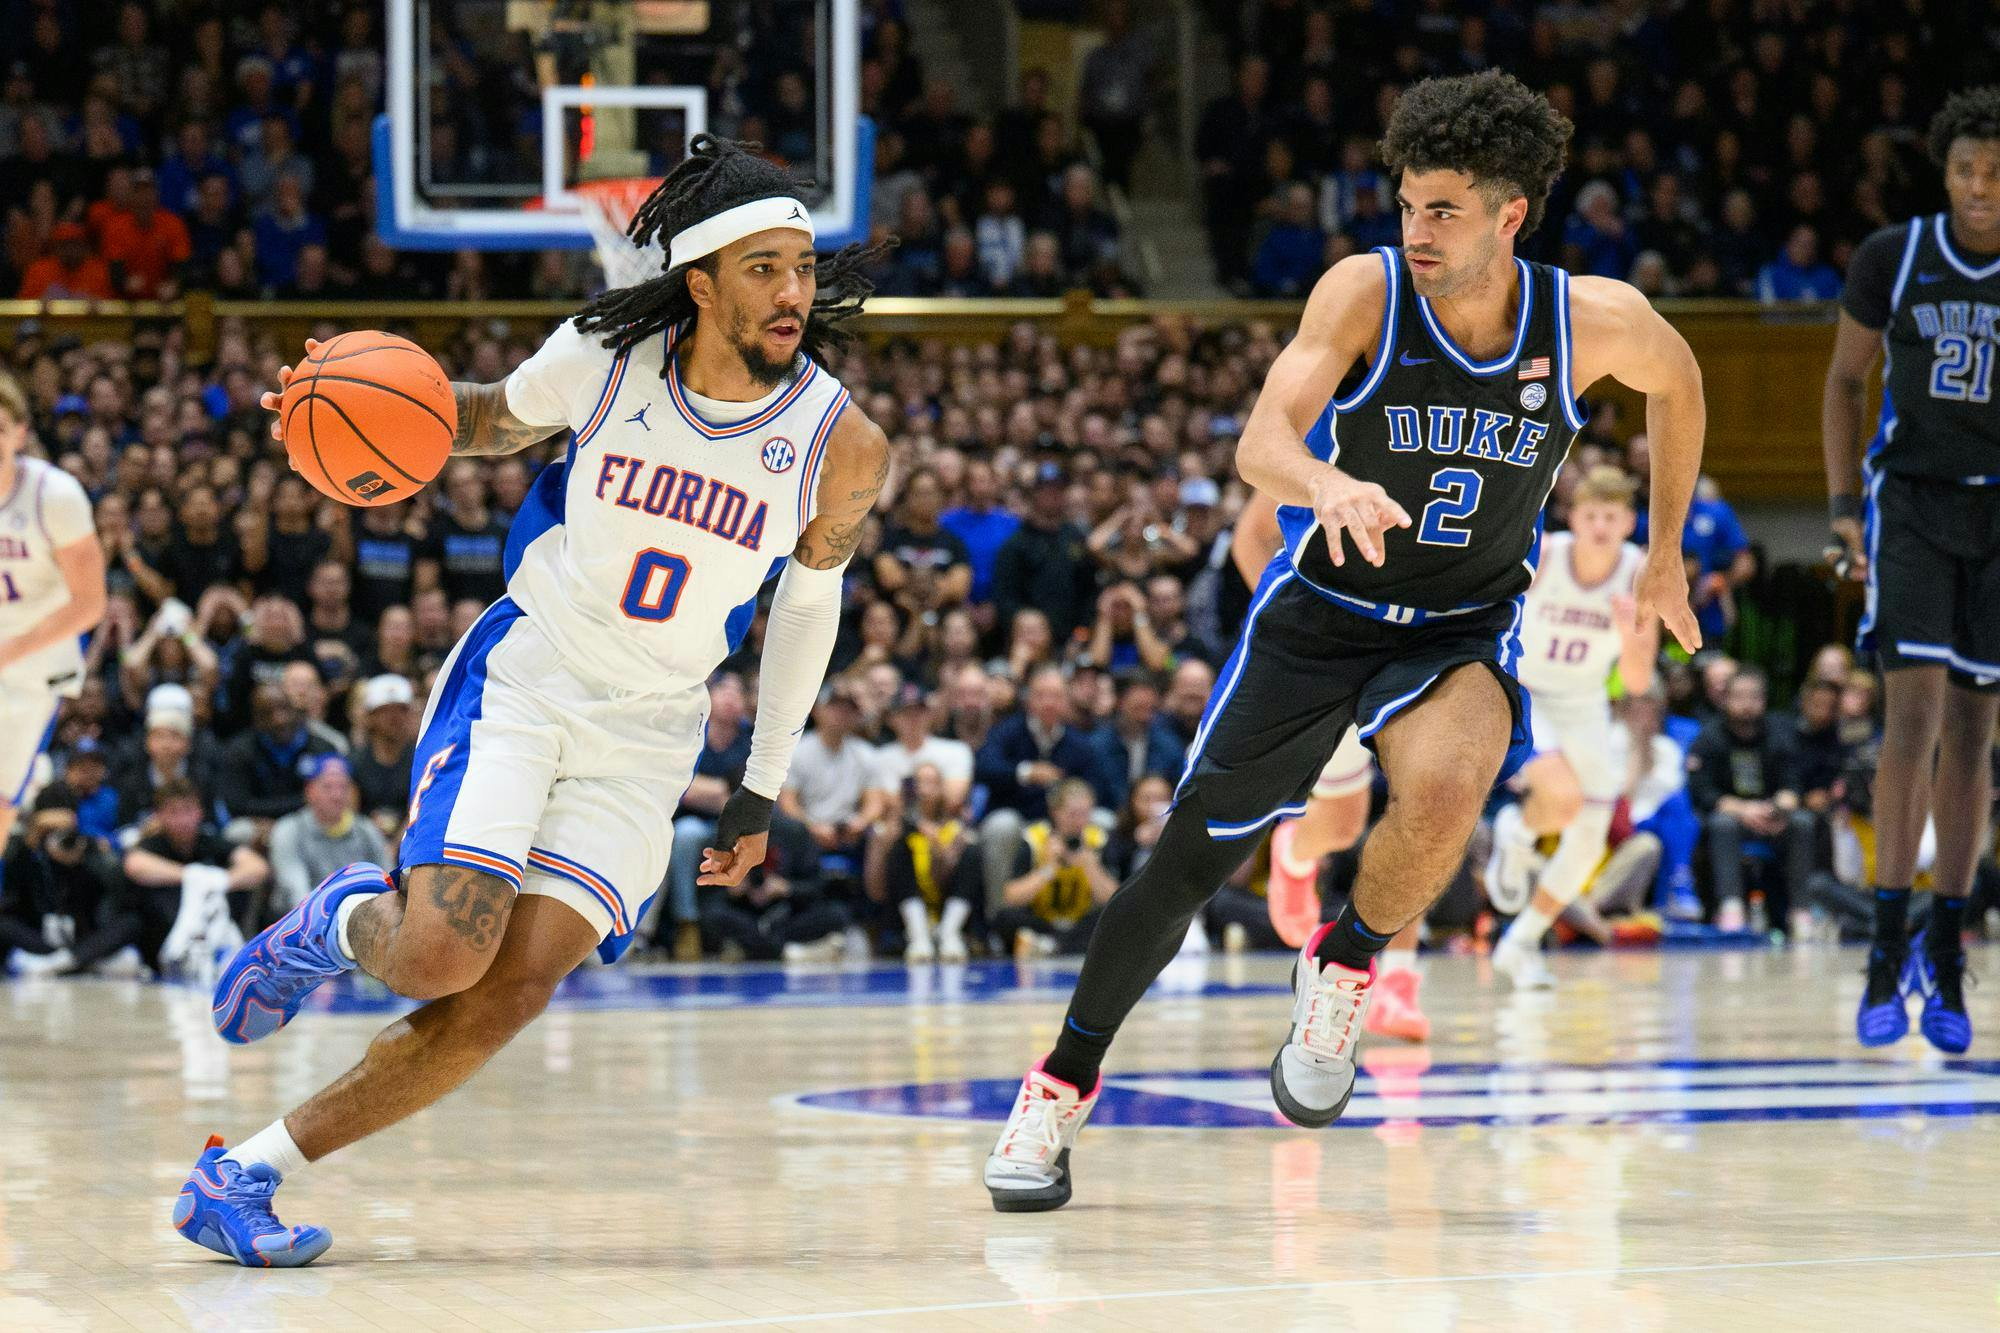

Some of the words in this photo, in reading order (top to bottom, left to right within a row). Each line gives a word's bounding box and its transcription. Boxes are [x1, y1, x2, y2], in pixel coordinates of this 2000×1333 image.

[1911, 300, 2000, 343] DUK
[1929, 331, 1995, 403] 21
[762, 439, 794, 472] SEC
[1384, 404, 1550, 468] DUKE
[595, 453, 769, 552] FLORIDA
[1416, 466, 1485, 547] 2
[619, 546, 693, 624] 0
[1547, 637, 1590, 664] 10
